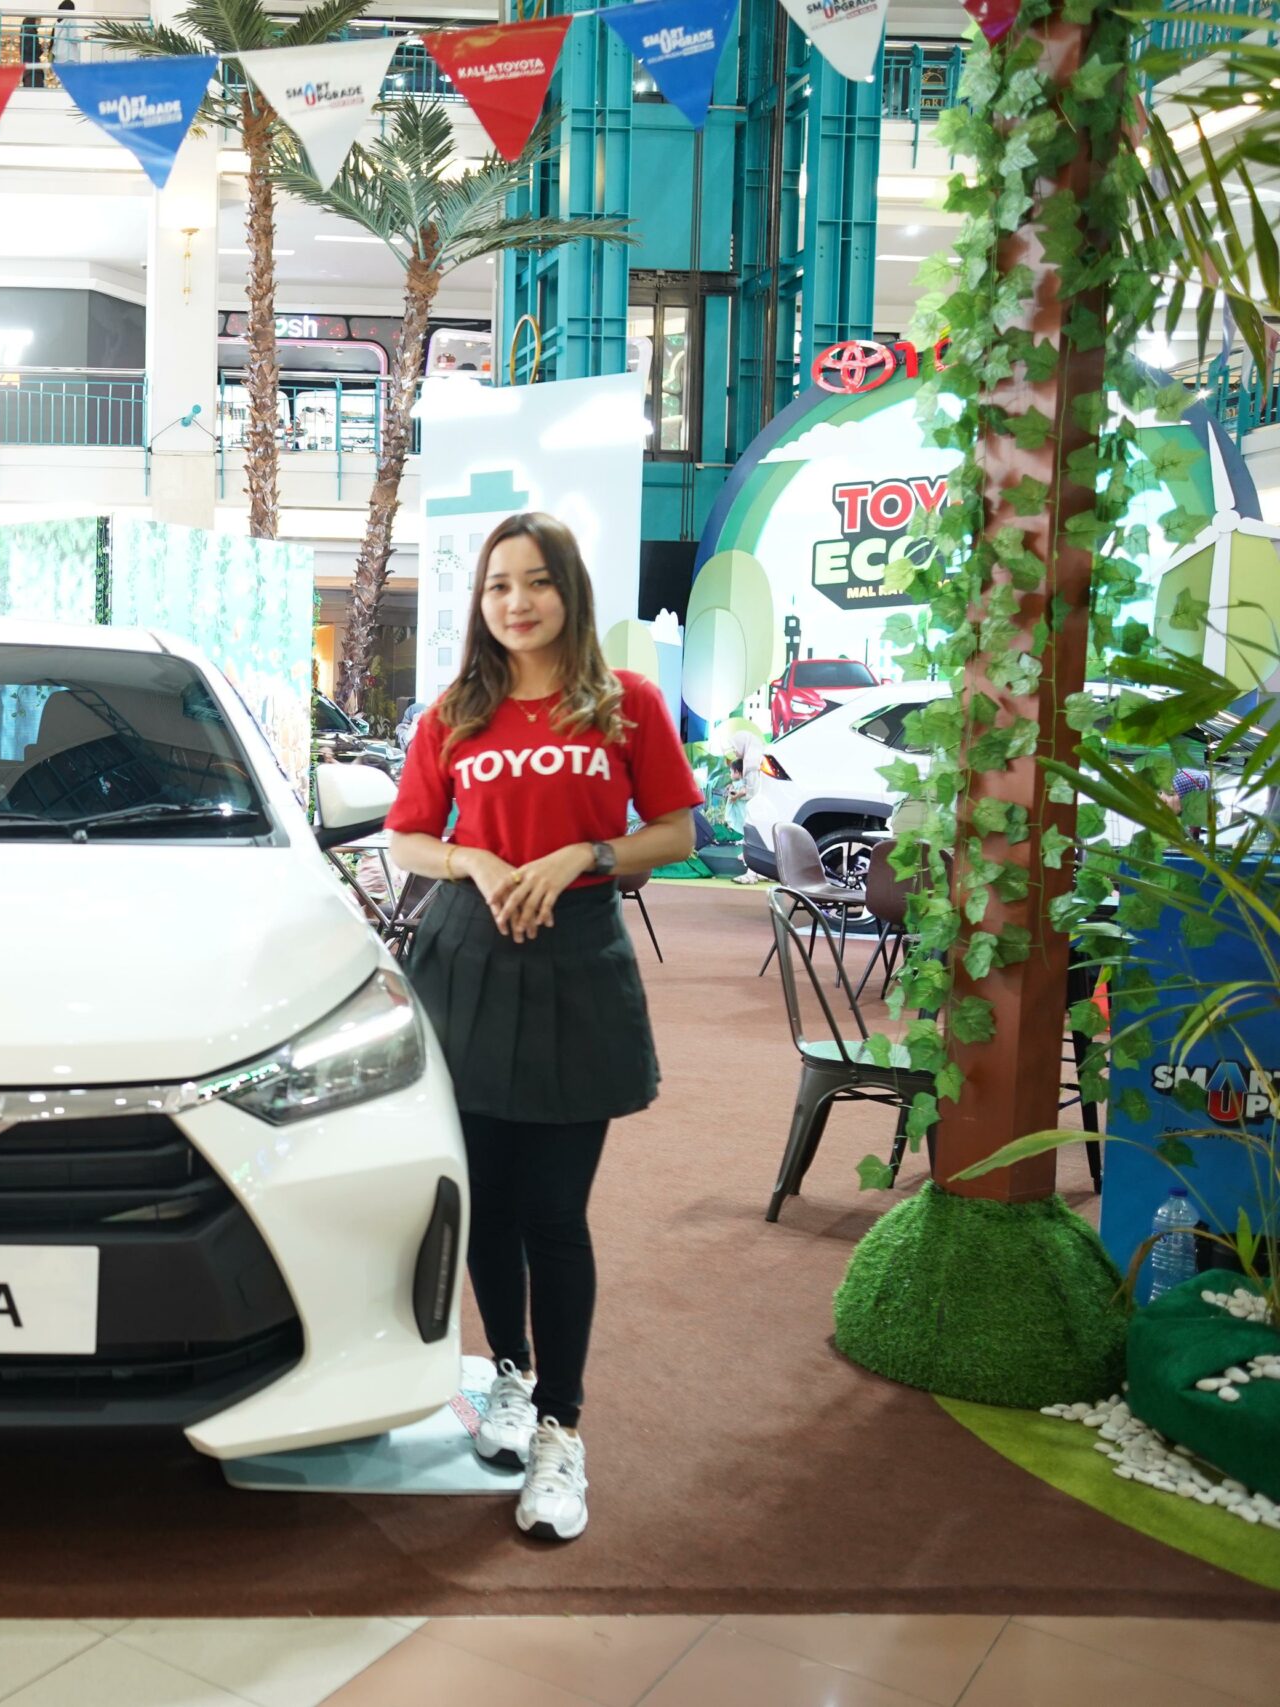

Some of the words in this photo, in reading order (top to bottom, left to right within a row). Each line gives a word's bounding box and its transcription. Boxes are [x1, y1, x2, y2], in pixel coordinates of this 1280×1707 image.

[642, 26, 684, 48] SMART
[660, 29, 714, 54] UPGRADE
[457, 64, 496, 79] KALLA
[496, 58, 544, 73] TOYOTA
[99, 95, 147, 115] SMART
[119, 100, 181, 123] UPGRADE
[274, 315, 318, 338] osh
[846, 585, 876, 599] MAL
[455, 744, 611, 790] TOYOTA
